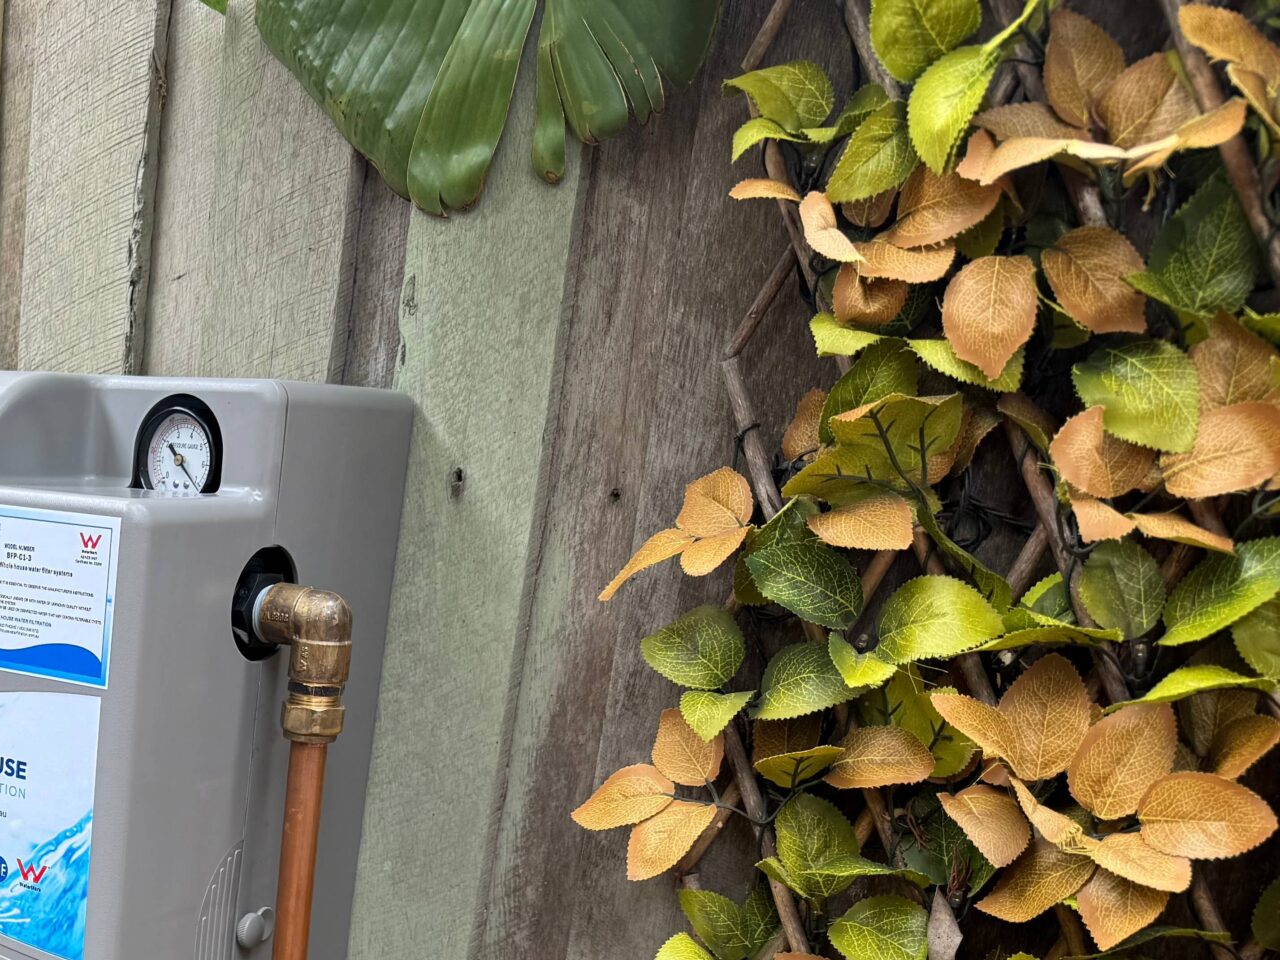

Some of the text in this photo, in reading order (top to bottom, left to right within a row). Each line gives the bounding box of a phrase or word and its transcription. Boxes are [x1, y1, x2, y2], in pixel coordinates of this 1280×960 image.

[6, 552, 32, 562] BFP-C1-3
[0, 561, 13, 569] Whole
[14, 563, 28, 571] house
[53, 569, 73, 578] systems
